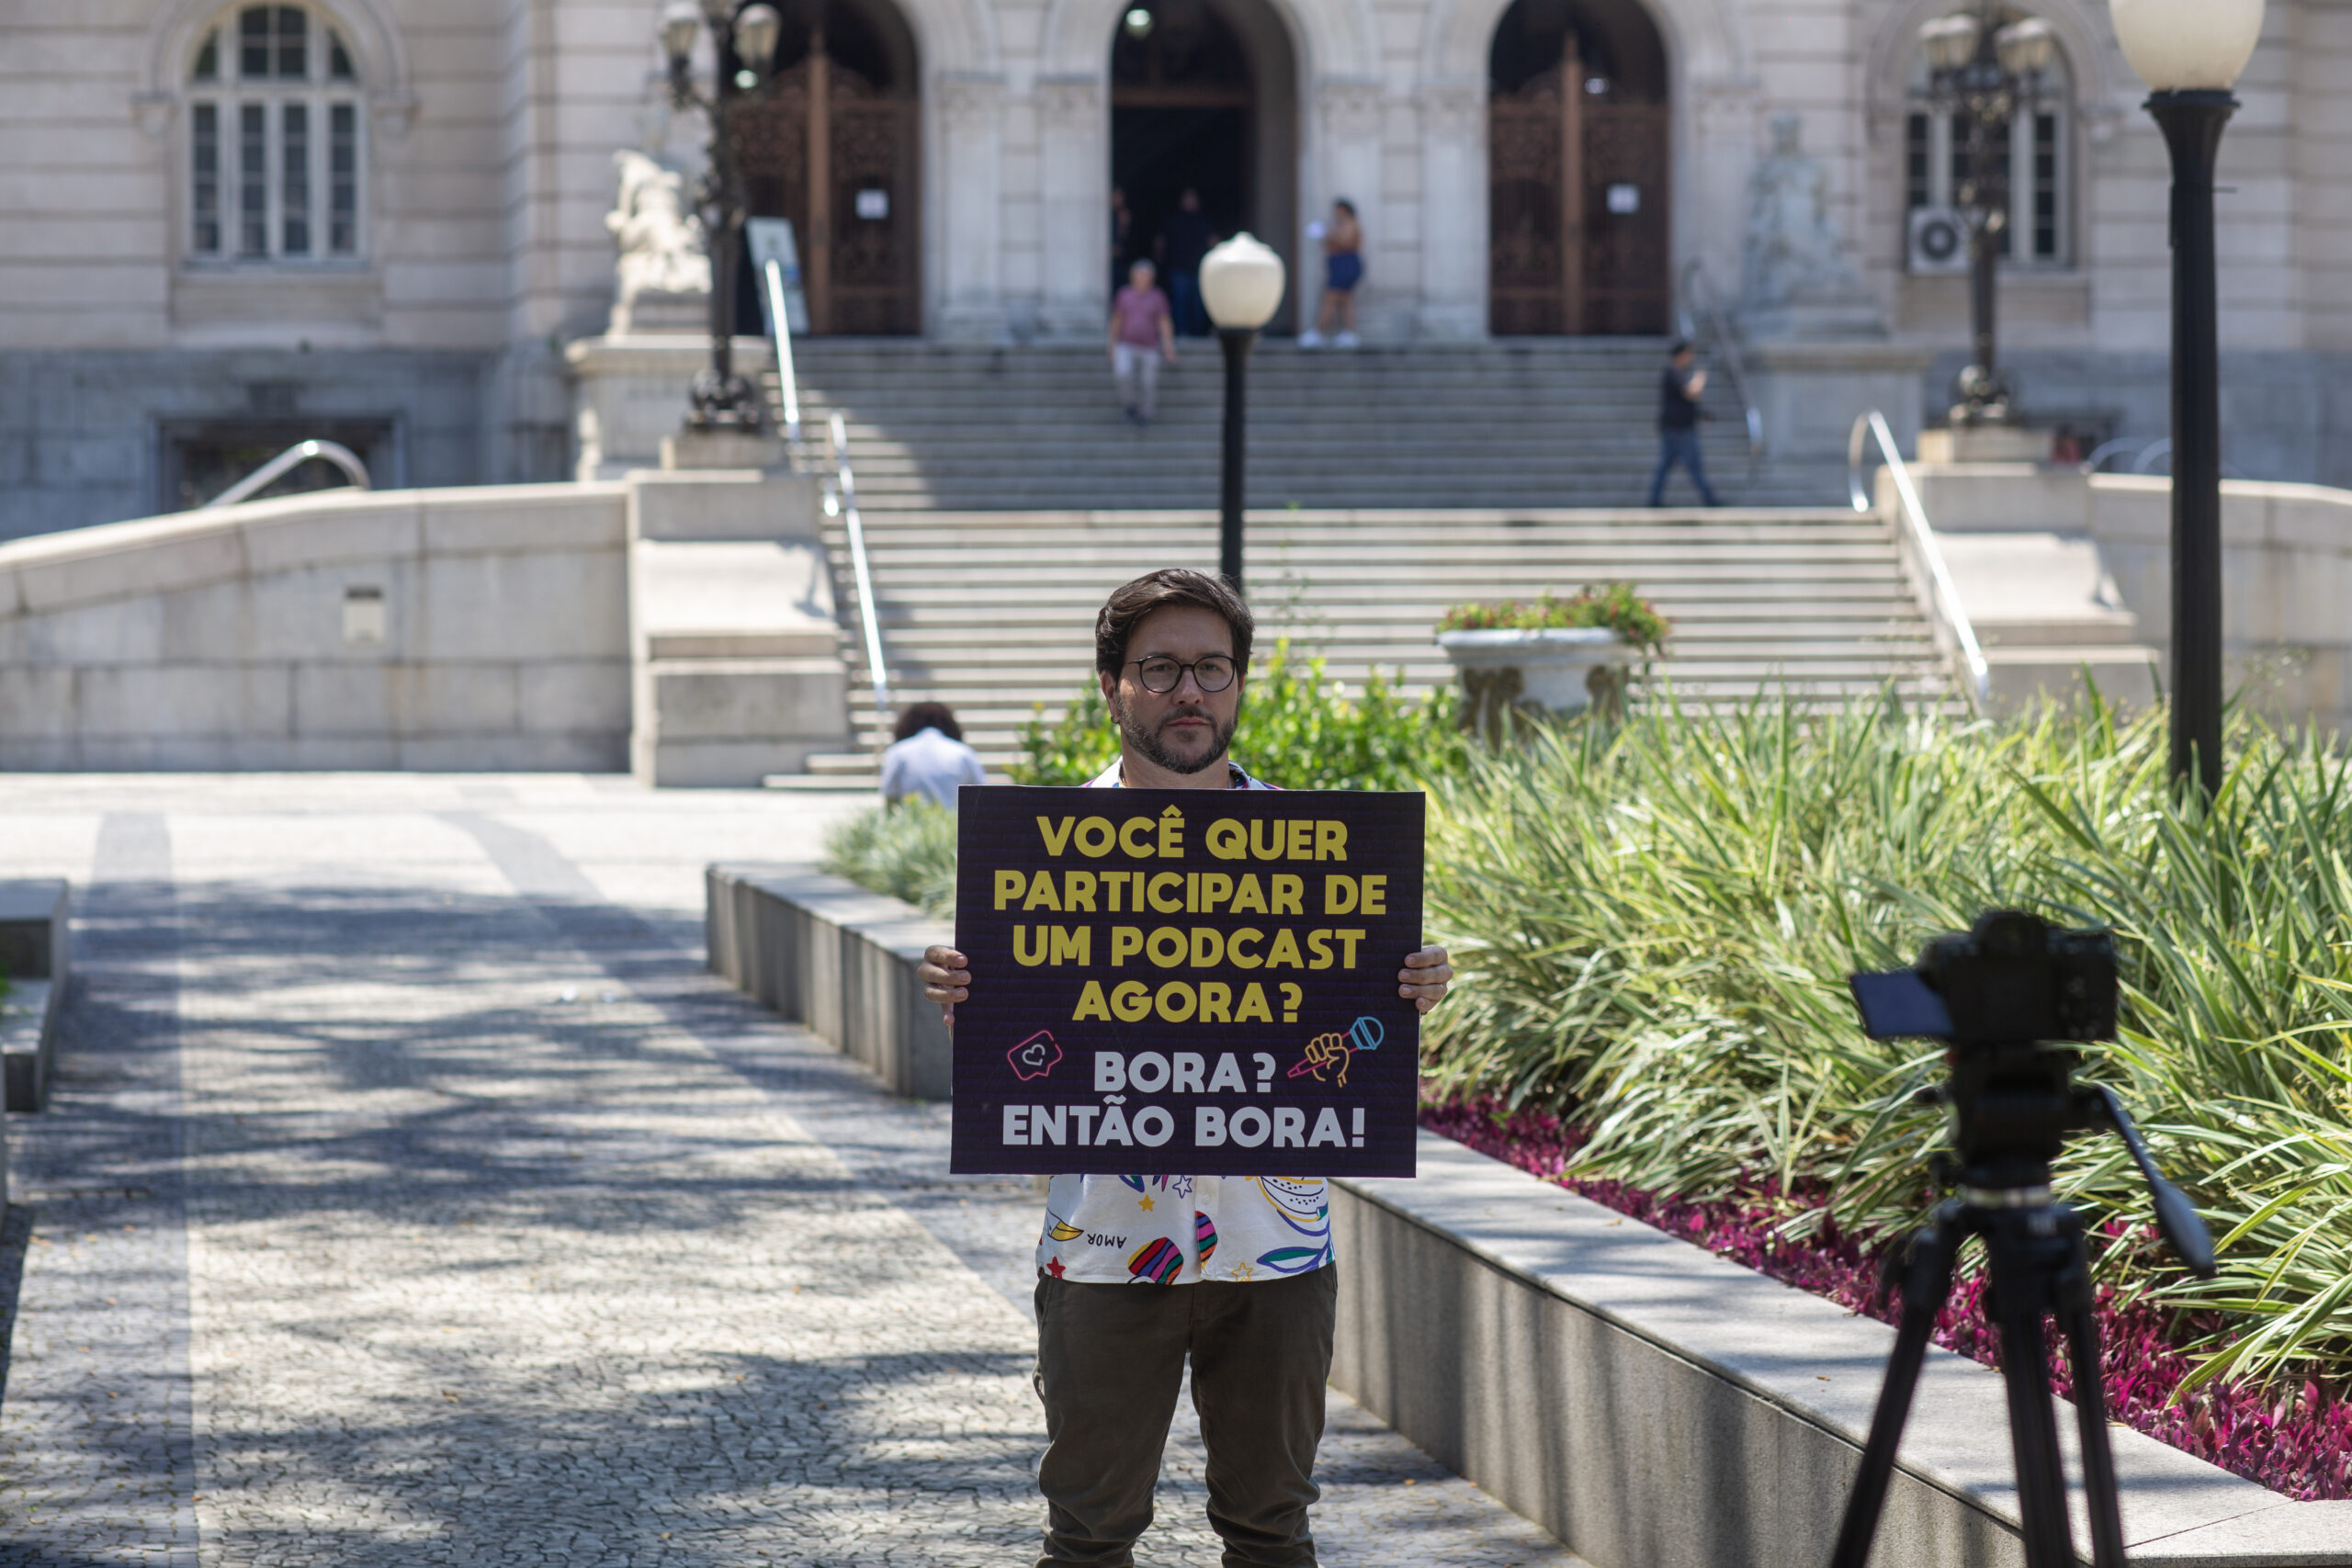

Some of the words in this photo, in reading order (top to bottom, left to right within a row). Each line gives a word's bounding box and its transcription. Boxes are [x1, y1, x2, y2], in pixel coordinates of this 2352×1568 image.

[1036, 805, 1184, 858] VOCÊ
[1205, 818, 1347, 861] QUER
[994, 870, 1304, 914] PARTICIPAR
[1325, 874, 1386, 914] DE
[1013, 925, 1091, 966] UM
[1112, 927, 1365, 969] PODCAST
[1072, 981, 1302, 1022] AGORA?
[1094, 1052, 1275, 1092] BORA?
[1003, 1094, 1174, 1146] ENTÃO
[1195, 1106, 1364, 1147] BORA!
[1088, 1233, 1127, 1249] AMOR
